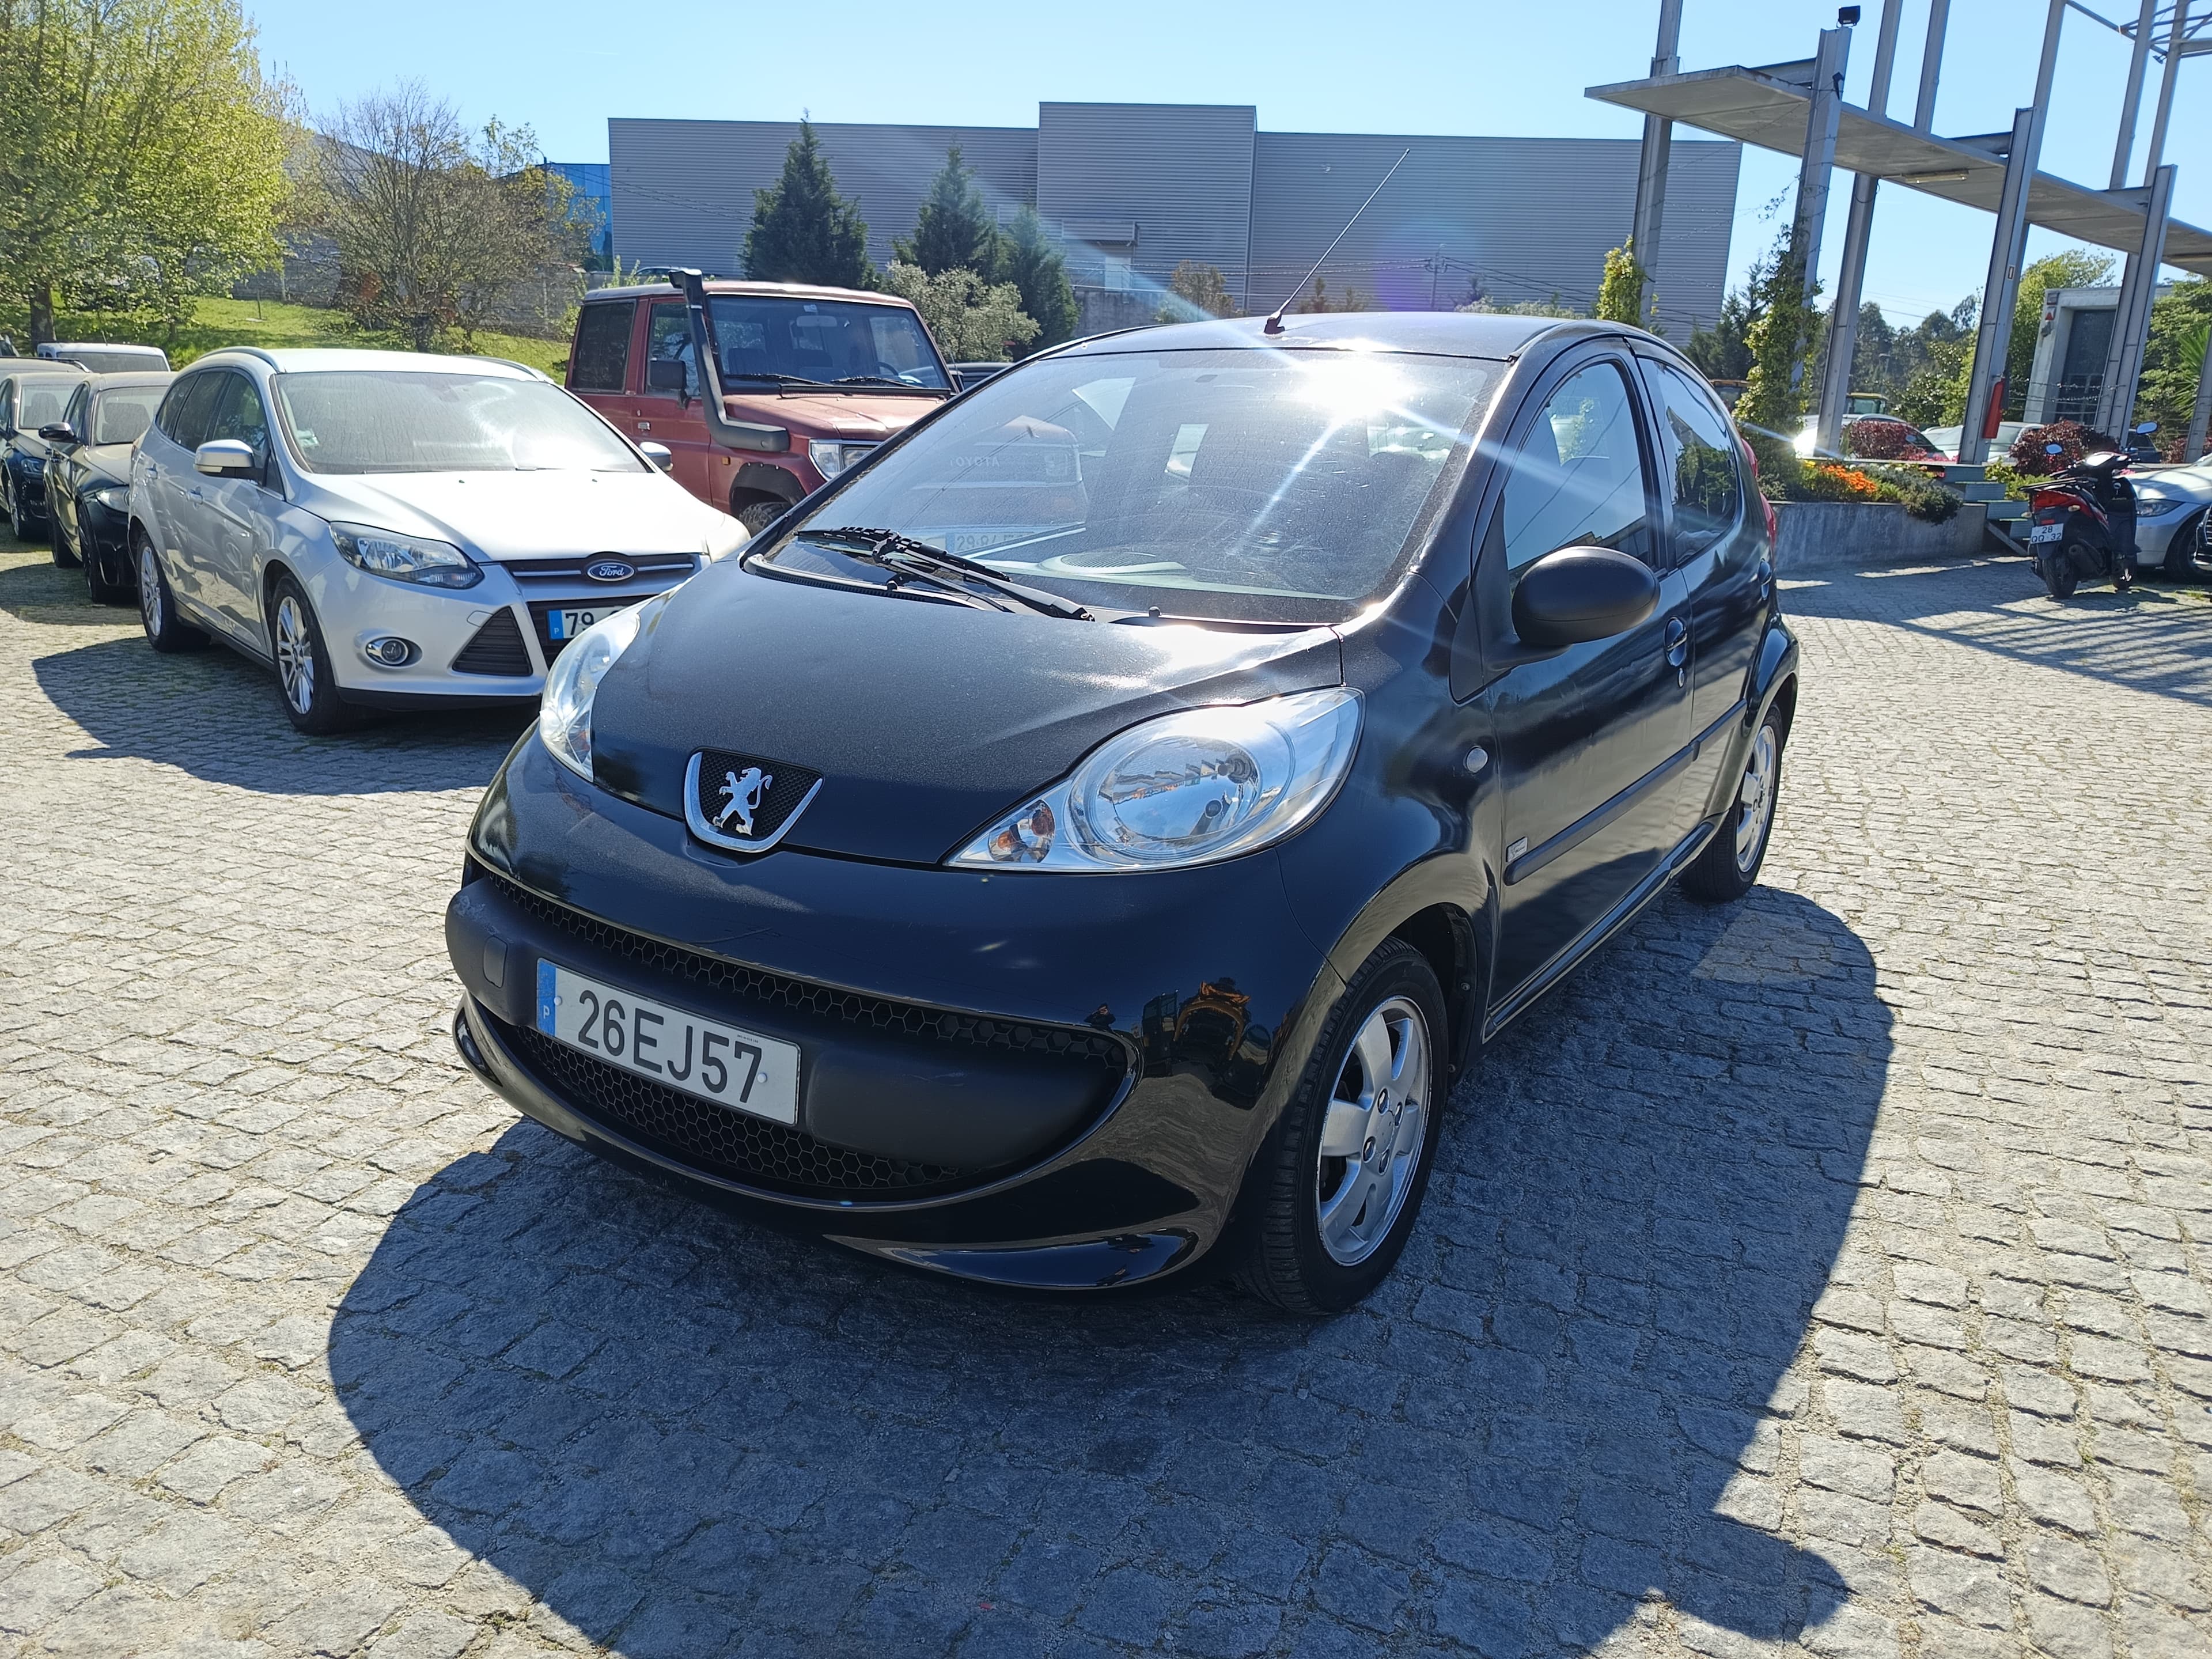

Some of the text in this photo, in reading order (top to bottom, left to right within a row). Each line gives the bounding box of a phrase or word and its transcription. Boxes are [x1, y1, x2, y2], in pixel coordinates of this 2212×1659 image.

[2041, 525, 2053, 534] 28
[2051, 532, 2061, 540] 32
[599, 565, 624, 576] Ford
[543, 990, 762, 1104] P 26EJ57
